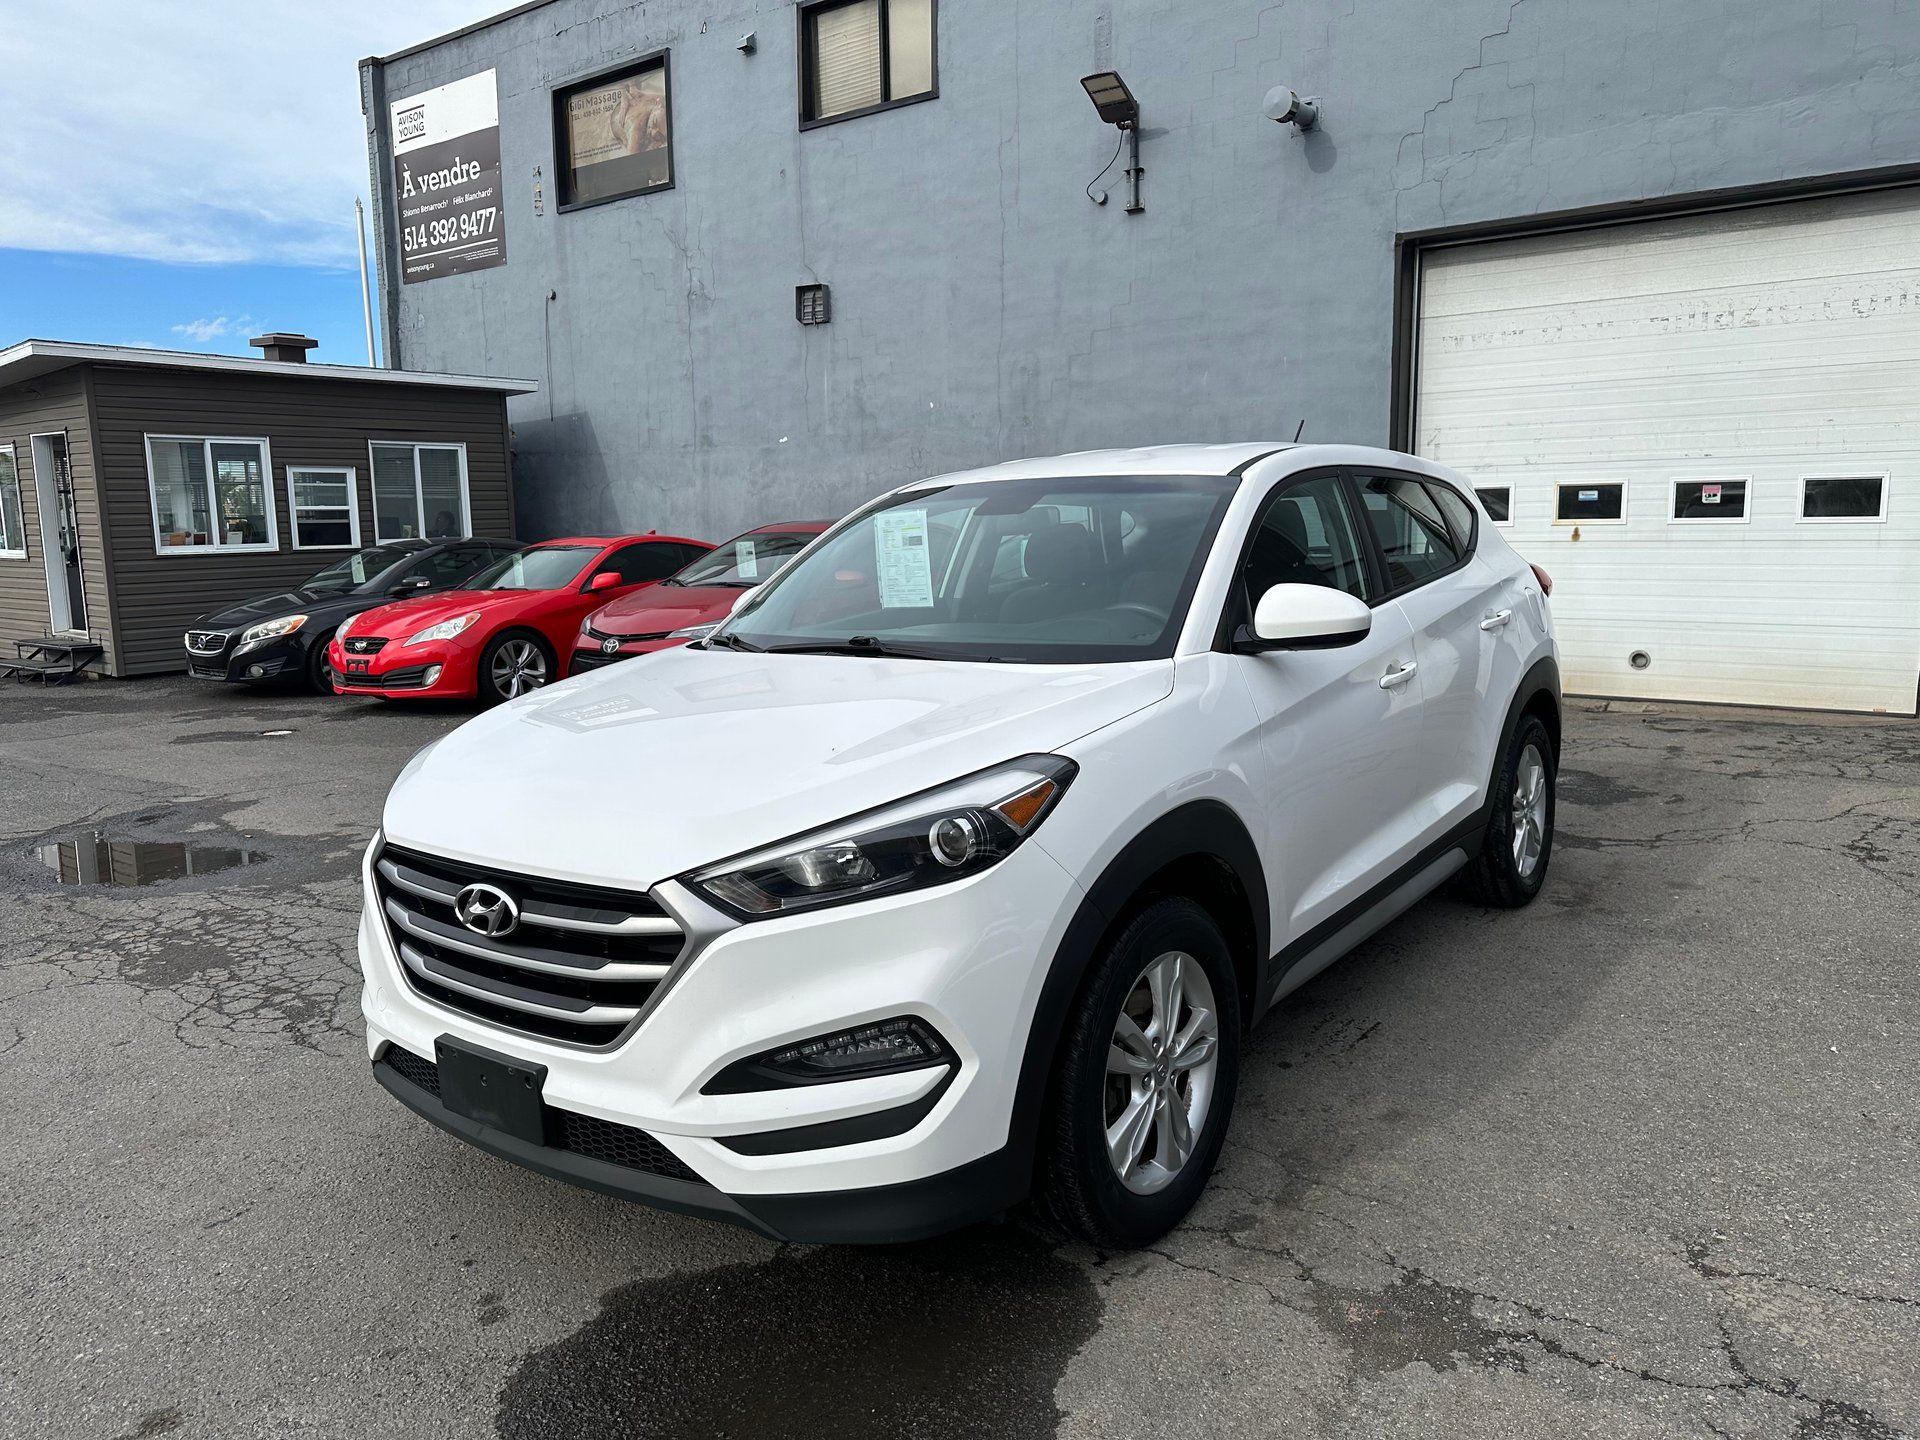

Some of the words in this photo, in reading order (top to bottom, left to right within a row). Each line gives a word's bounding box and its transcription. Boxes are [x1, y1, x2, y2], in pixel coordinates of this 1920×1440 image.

[586, 90, 622, 107] Massage
[398, 110, 424, 127] AVISON
[399, 122, 425, 138] YOUNG
[402, 163, 416, 199] À
[418, 156, 481, 193] vendre
[404, 223, 428, 252] 514
[429, 217, 458, 246] 392
[460, 206, 497, 239] 9477
